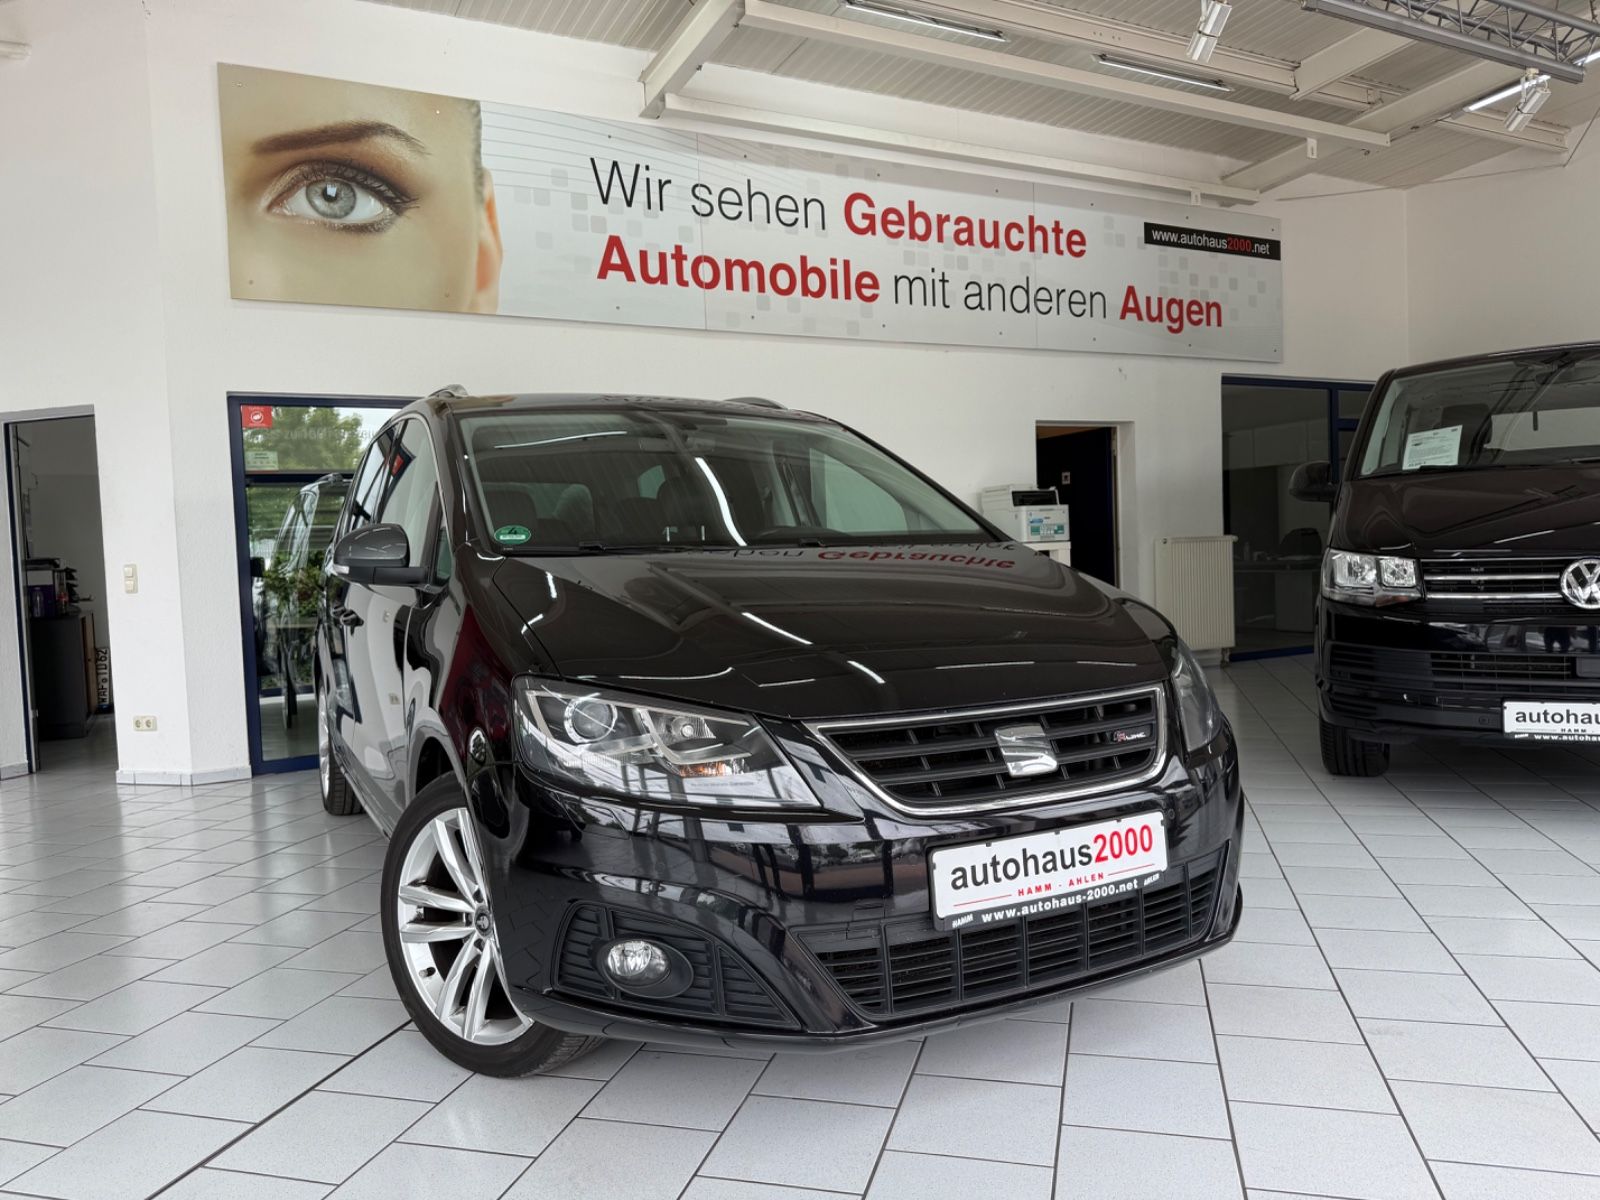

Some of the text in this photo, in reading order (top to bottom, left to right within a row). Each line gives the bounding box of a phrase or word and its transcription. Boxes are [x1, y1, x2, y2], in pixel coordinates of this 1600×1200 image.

[590, 157, 1087, 258] Wir sehen Gebrauchte
[1152, 229, 1270, 255] www.autohaus2000.net
[597, 235, 1222, 334] Automobile mit anderen Augen
[950, 824, 1153, 890] autohaus2000
[1018, 882, 1052, 896] HAMM
[1068, 872, 1104, 887] AHLEN
[981, 879, 1138, 923] www.autohaus-2000.net
